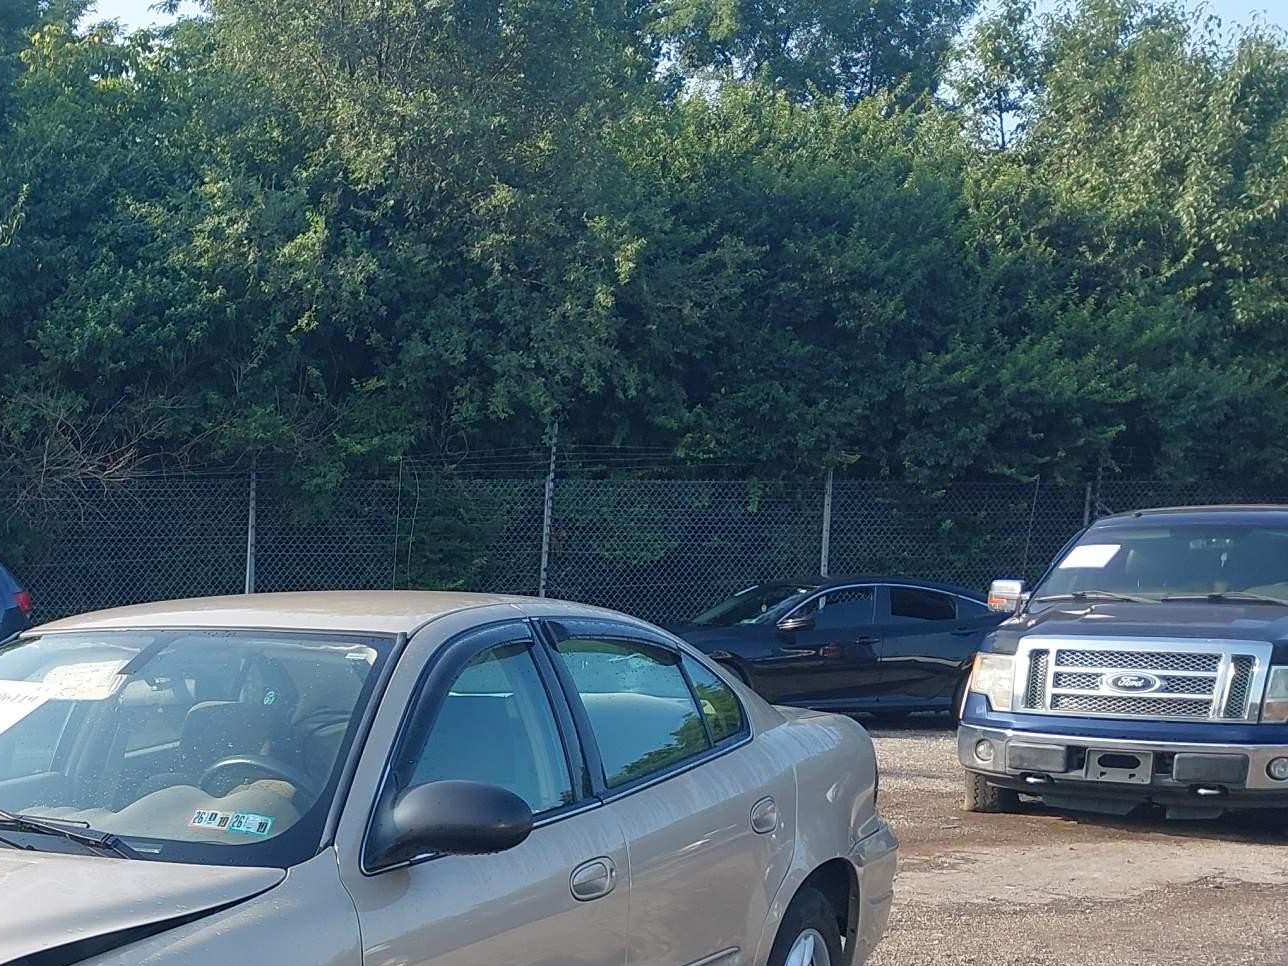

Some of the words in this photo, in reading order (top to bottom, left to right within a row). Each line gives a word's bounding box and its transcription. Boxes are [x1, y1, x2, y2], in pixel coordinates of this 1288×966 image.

[1118, 676, 1145, 687] Ford
[192, 810, 206, 824] 26
[231, 814, 246, 828] 26
